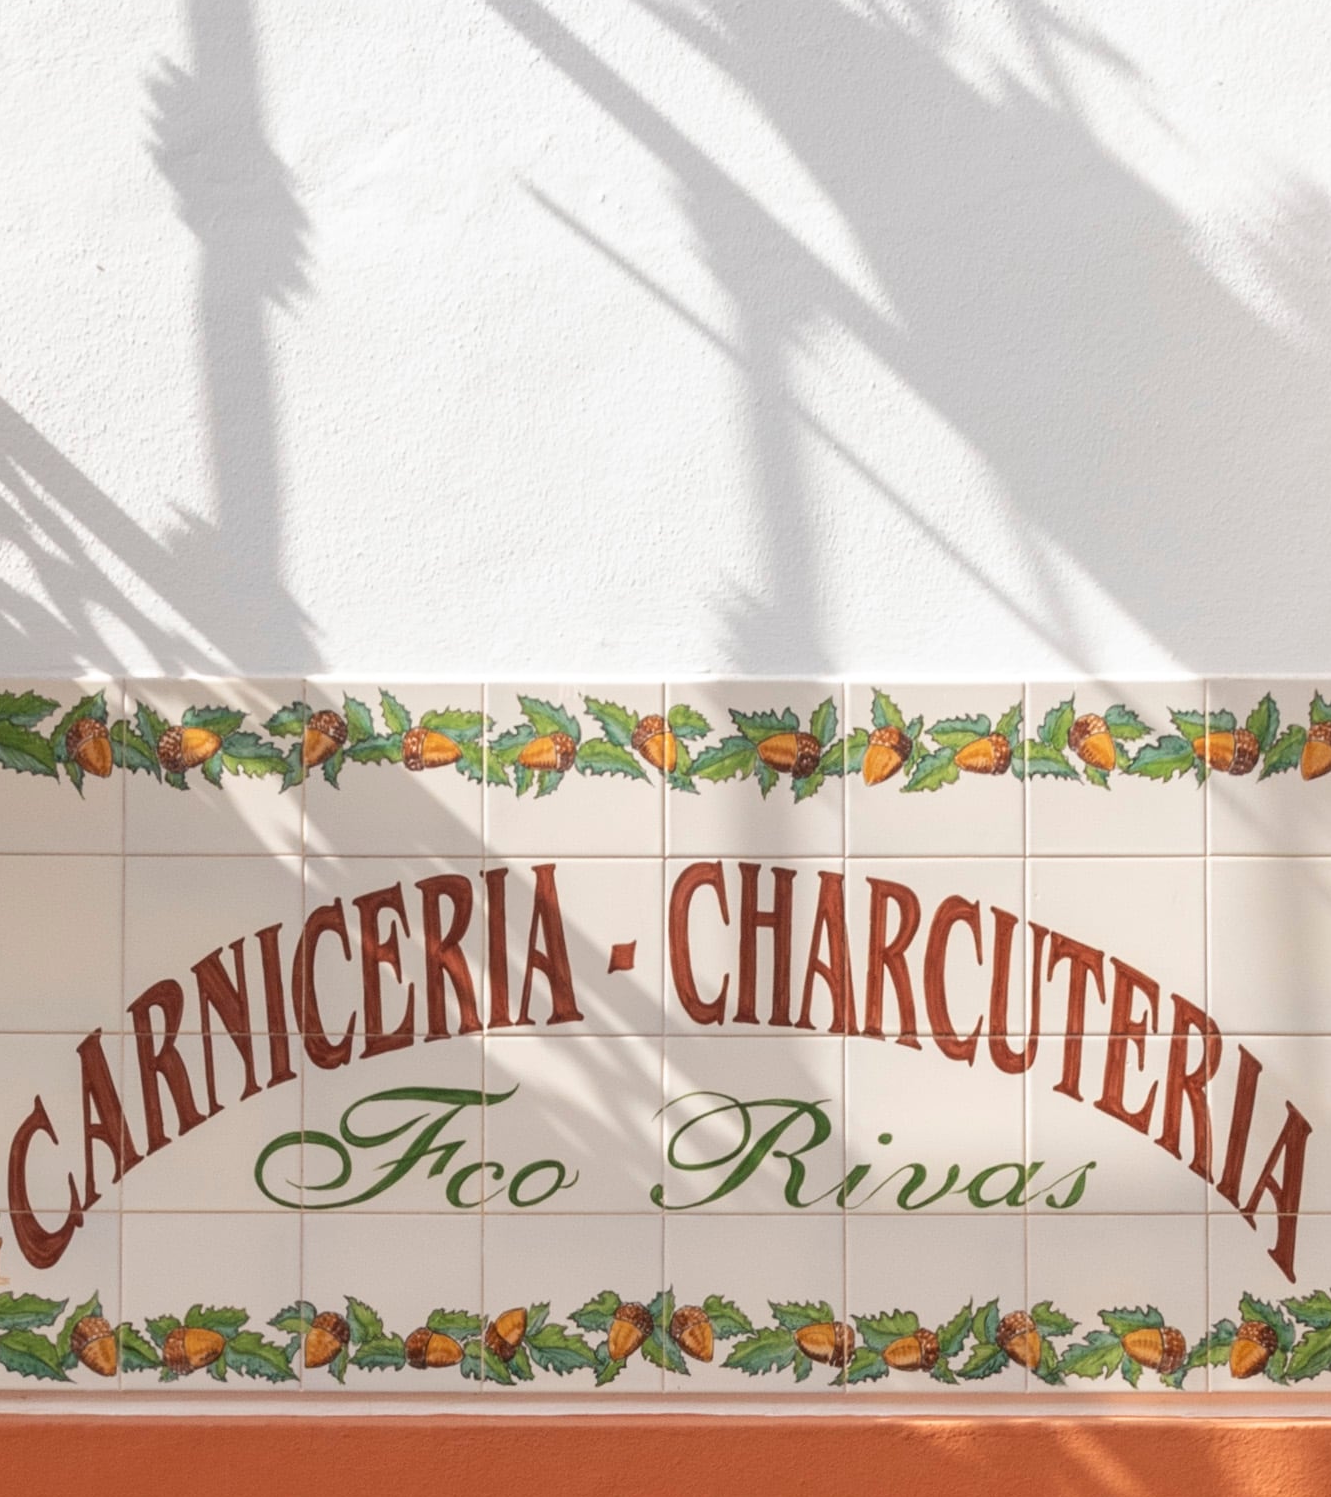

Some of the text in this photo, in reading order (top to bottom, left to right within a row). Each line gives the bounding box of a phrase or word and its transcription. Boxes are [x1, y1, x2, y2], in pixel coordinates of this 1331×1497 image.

[8, 862, 585, 1270] CARNICERIA
[669, 860, 1314, 1284] CHARCUTERIA
[254, 1083, 1098, 1213] Fco Rivas
